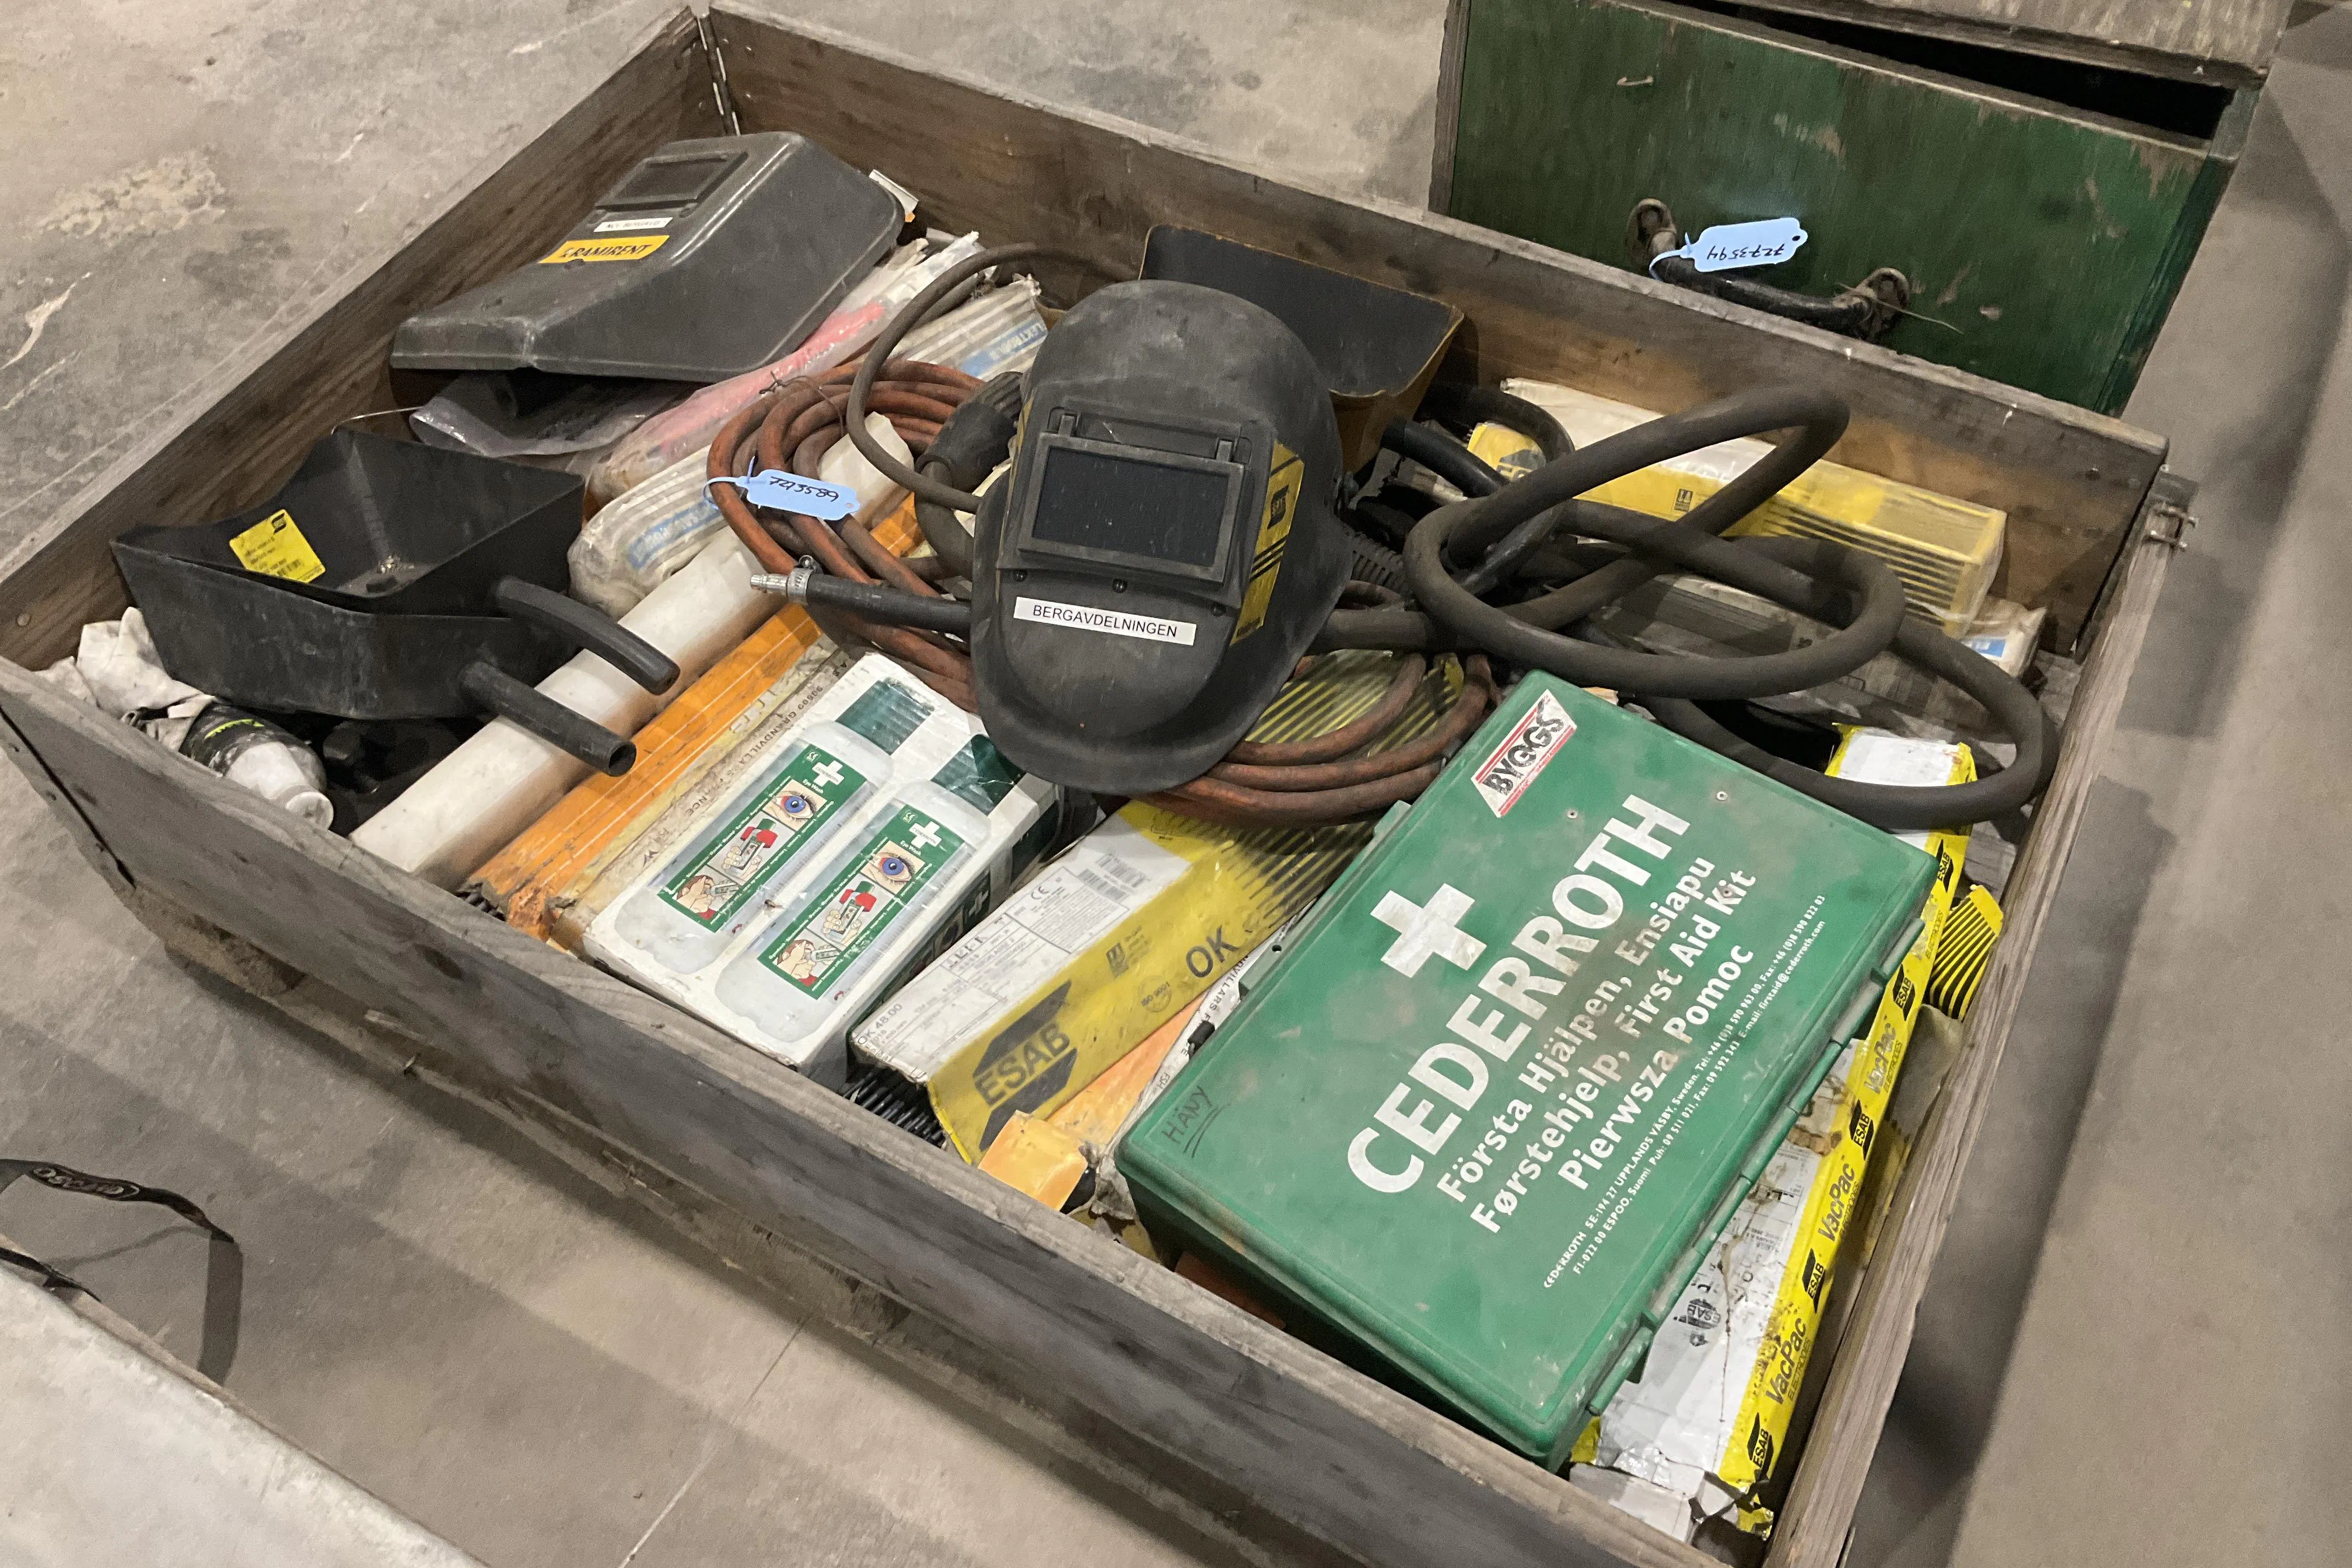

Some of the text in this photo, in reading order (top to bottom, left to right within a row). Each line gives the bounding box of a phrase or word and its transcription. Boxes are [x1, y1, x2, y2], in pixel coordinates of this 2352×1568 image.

[1707, 243, 1786, 261] 7273594
[1032, 604, 1177, 638] BERGAVDELNINGEN
[725, 710, 797, 779] GRANDVILLAS
[1482, 699, 1564, 797] BYGGS
[1936, 852, 1953, 882] ESAB
[1185, 926, 1241, 978] OK
[1923, 909, 1947, 959] ELECTRODES
[1348, 794, 1690, 1193] CEDERROTH
[1896, 977, 1912, 1010] ESAB
[856, 1028, 876, 1046] OK
[1437, 858, 1715, 1202] Första Hjälpen, Ensiapu
[1471, 870, 1756, 1233] Førstehjelp, First Aid Kit
[974, 1023, 1071, 1107] ESAB
[1541, 1230, 1588, 1290] CEDERROTH
[1605, 1185, 1619, 1199] 27
[1612, 1134, 1655, 1188] UPPLANDS
[1705, 1040, 1721, 1058] +46
[1728, 1007, 1745, 1025] 590
[1739, 992, 1756, 1010] 963
[1759, 963, 1777, 983] Fax:
[1770, 949, 1787, 966] +46
[1781, 932, 1800, 952] (0)8
[1793, 918, 1809, 935] 590
[1803, 903, 1819, 921] 822
[1813, 892, 1826, 907] 03
[1558, 946, 1753, 1189] Pierwsza Pomoc
[1883, 1041, 1903, 1092] ELECTRODES
[1593, 1229, 1608, 1245] 00
[1661, 1132, 1676, 1147] 09
[1705, 1070, 1719, 1084] 09
[1713, 1054, 1730, 1073] 592
[1724, 1039, 1741, 1057] 343
[1854, 1112, 1871, 1147] ESAB
[1816, 1161, 1857, 1242] VacPac
[1809, 1262, 1825, 1298] ESAB
[1766, 1317, 1809, 1406] VacPac
[1787, 1338, 1810, 1401] ELECTRODES
[1752, 1428, 1769, 1468] ESAB
